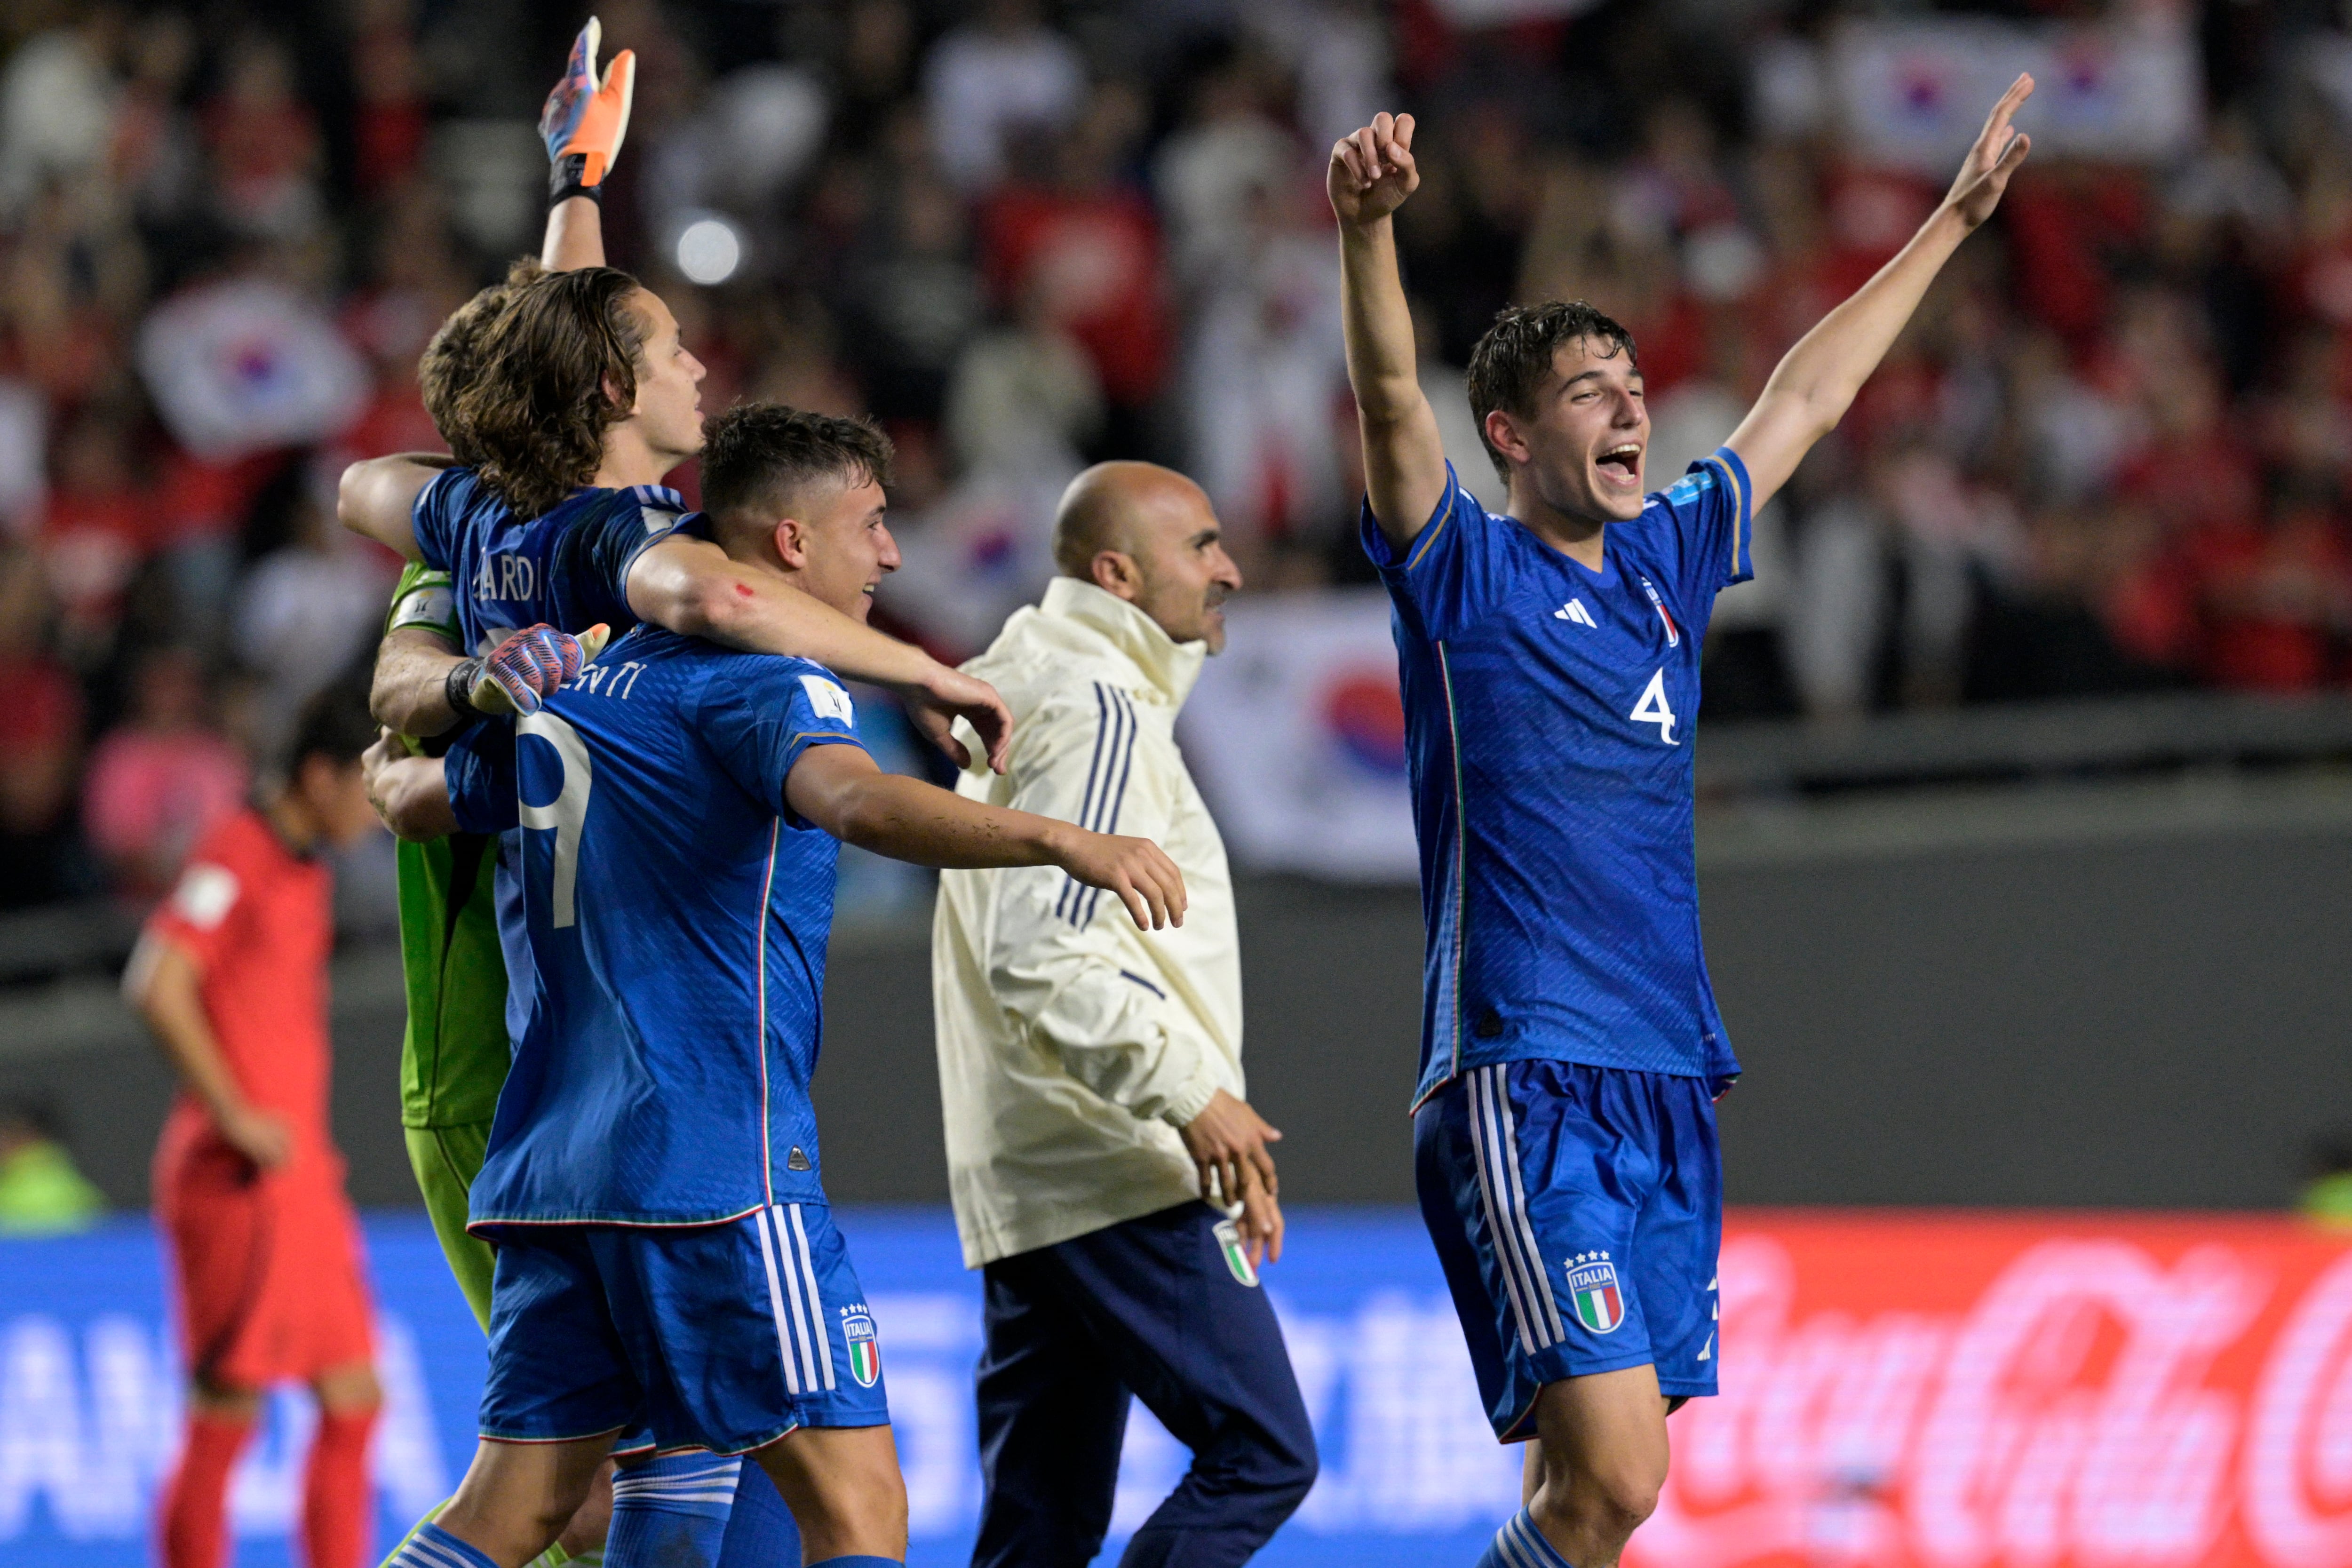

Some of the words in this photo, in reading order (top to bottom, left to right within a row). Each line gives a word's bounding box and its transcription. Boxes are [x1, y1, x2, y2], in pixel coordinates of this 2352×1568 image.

[559, 661, 647, 700] NTI
[1629, 667, 1680, 745] 4
[516, 710, 592, 929] 9
[1572, 1267, 1613, 1287] ITALIA
[846, 1321, 873, 1337] ITALIA
